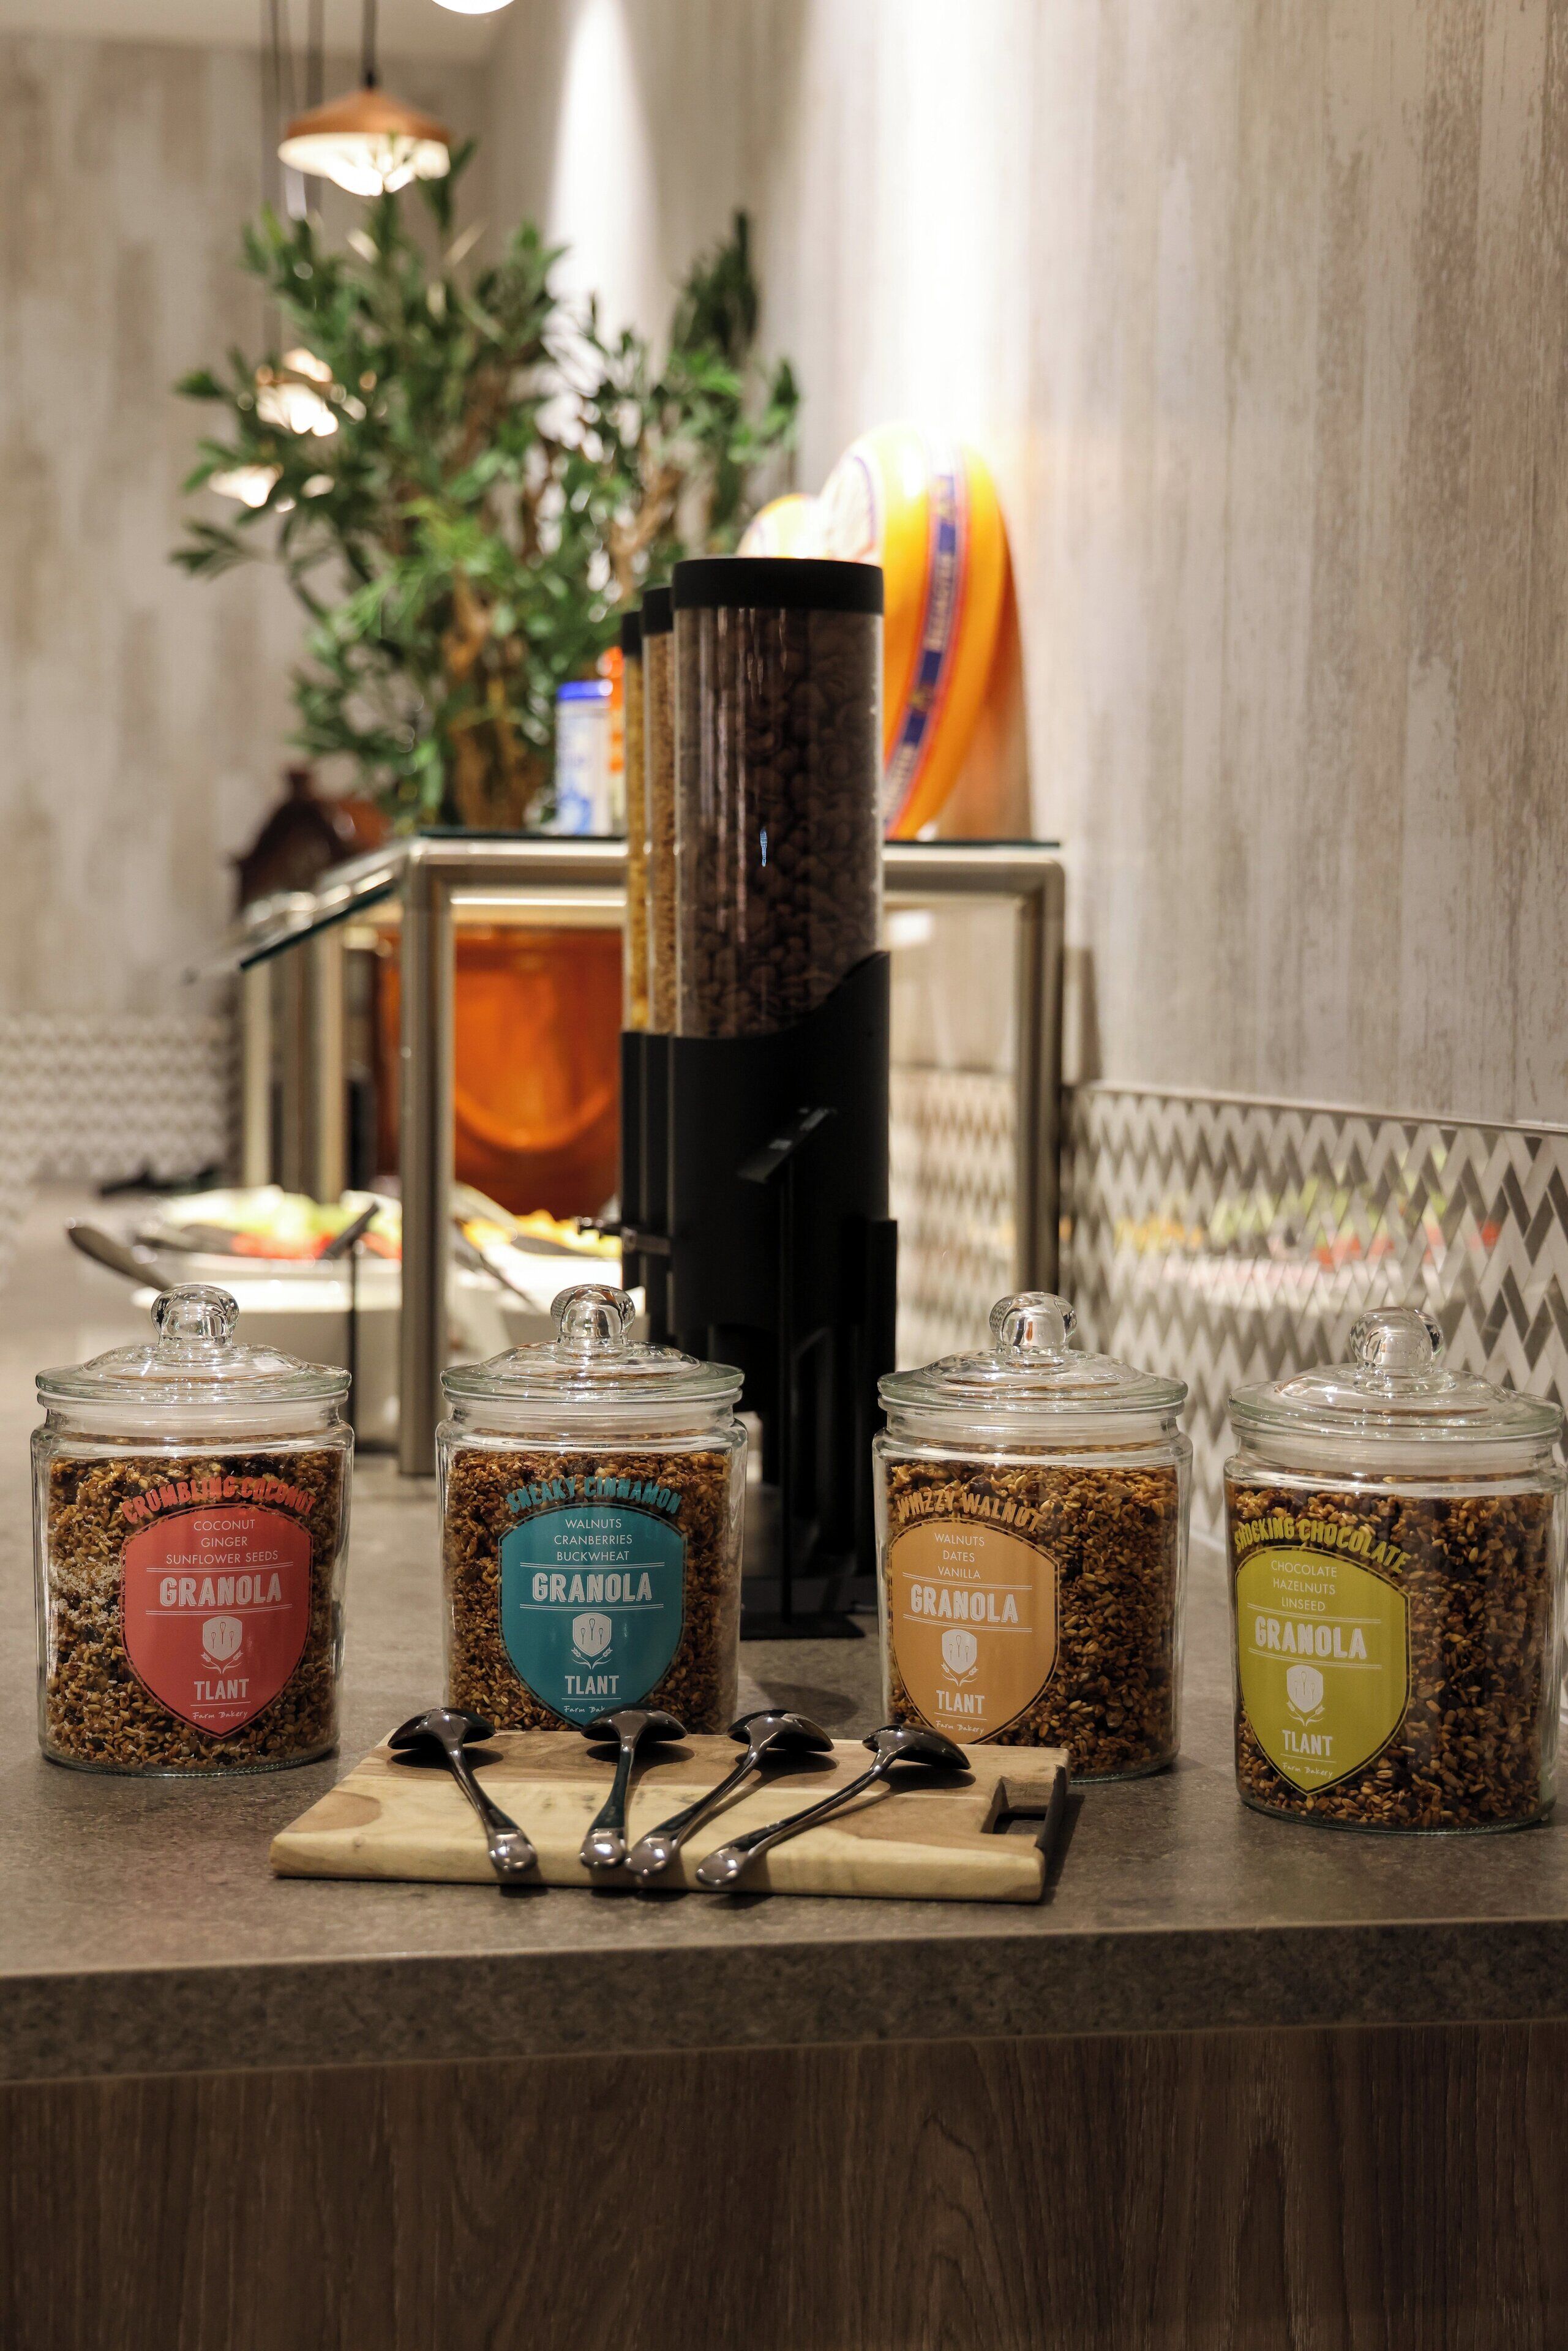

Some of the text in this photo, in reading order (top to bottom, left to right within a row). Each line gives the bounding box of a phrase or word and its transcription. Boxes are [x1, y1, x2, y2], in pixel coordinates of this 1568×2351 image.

[122, 1476, 317, 1523] CRUMBLING COCONUT
[506, 1476, 683, 1514] SNEAKY CINNAMON
[897, 1490, 1044, 1532] WHIZZY WALNUT
[193, 1519, 255, 1531] COCONUT
[565, 1518, 621, 1529] WALNUTS
[201, 1537, 248, 1548] GINGER
[553, 1534, 632, 1545] CRANBERRIES
[934, 1532, 985, 1547] WALNUTS
[1234, 1517, 1412, 1575] SHOCKING CHOCOLATE
[166, 1550, 279, 1565] SUNFLOWER SEEDS
[557, 1550, 629, 1561] BUCKWHEAT
[942, 1550, 975, 1562] DATES
[937, 1566, 981, 1579] VANILLA
[1271, 1561, 1338, 1578] CHOCOLATE
[160, 1572, 282, 1607] GRANOLA
[532, 1572, 652, 1603] GRANOLA
[1273, 1578, 1336, 1595] HAZELNUTS
[910, 1584, 1019, 1623] GRANOLA
[1281, 1597, 1326, 1612] LINSEED
[1255, 1615, 1367, 1660] GRANOLA
[194, 1678, 249, 1700] TLANT
[565, 1675, 619, 1695] TLANT
[936, 1690, 985, 1714] TLANT
[192, 1711, 248, 1720] Farm Bakery
[936, 1720, 985, 1736] Farm Bakery
[1282, 1729, 1333, 1757] TLANT
[1281, 1762, 1332, 1779] Farm Bakery
